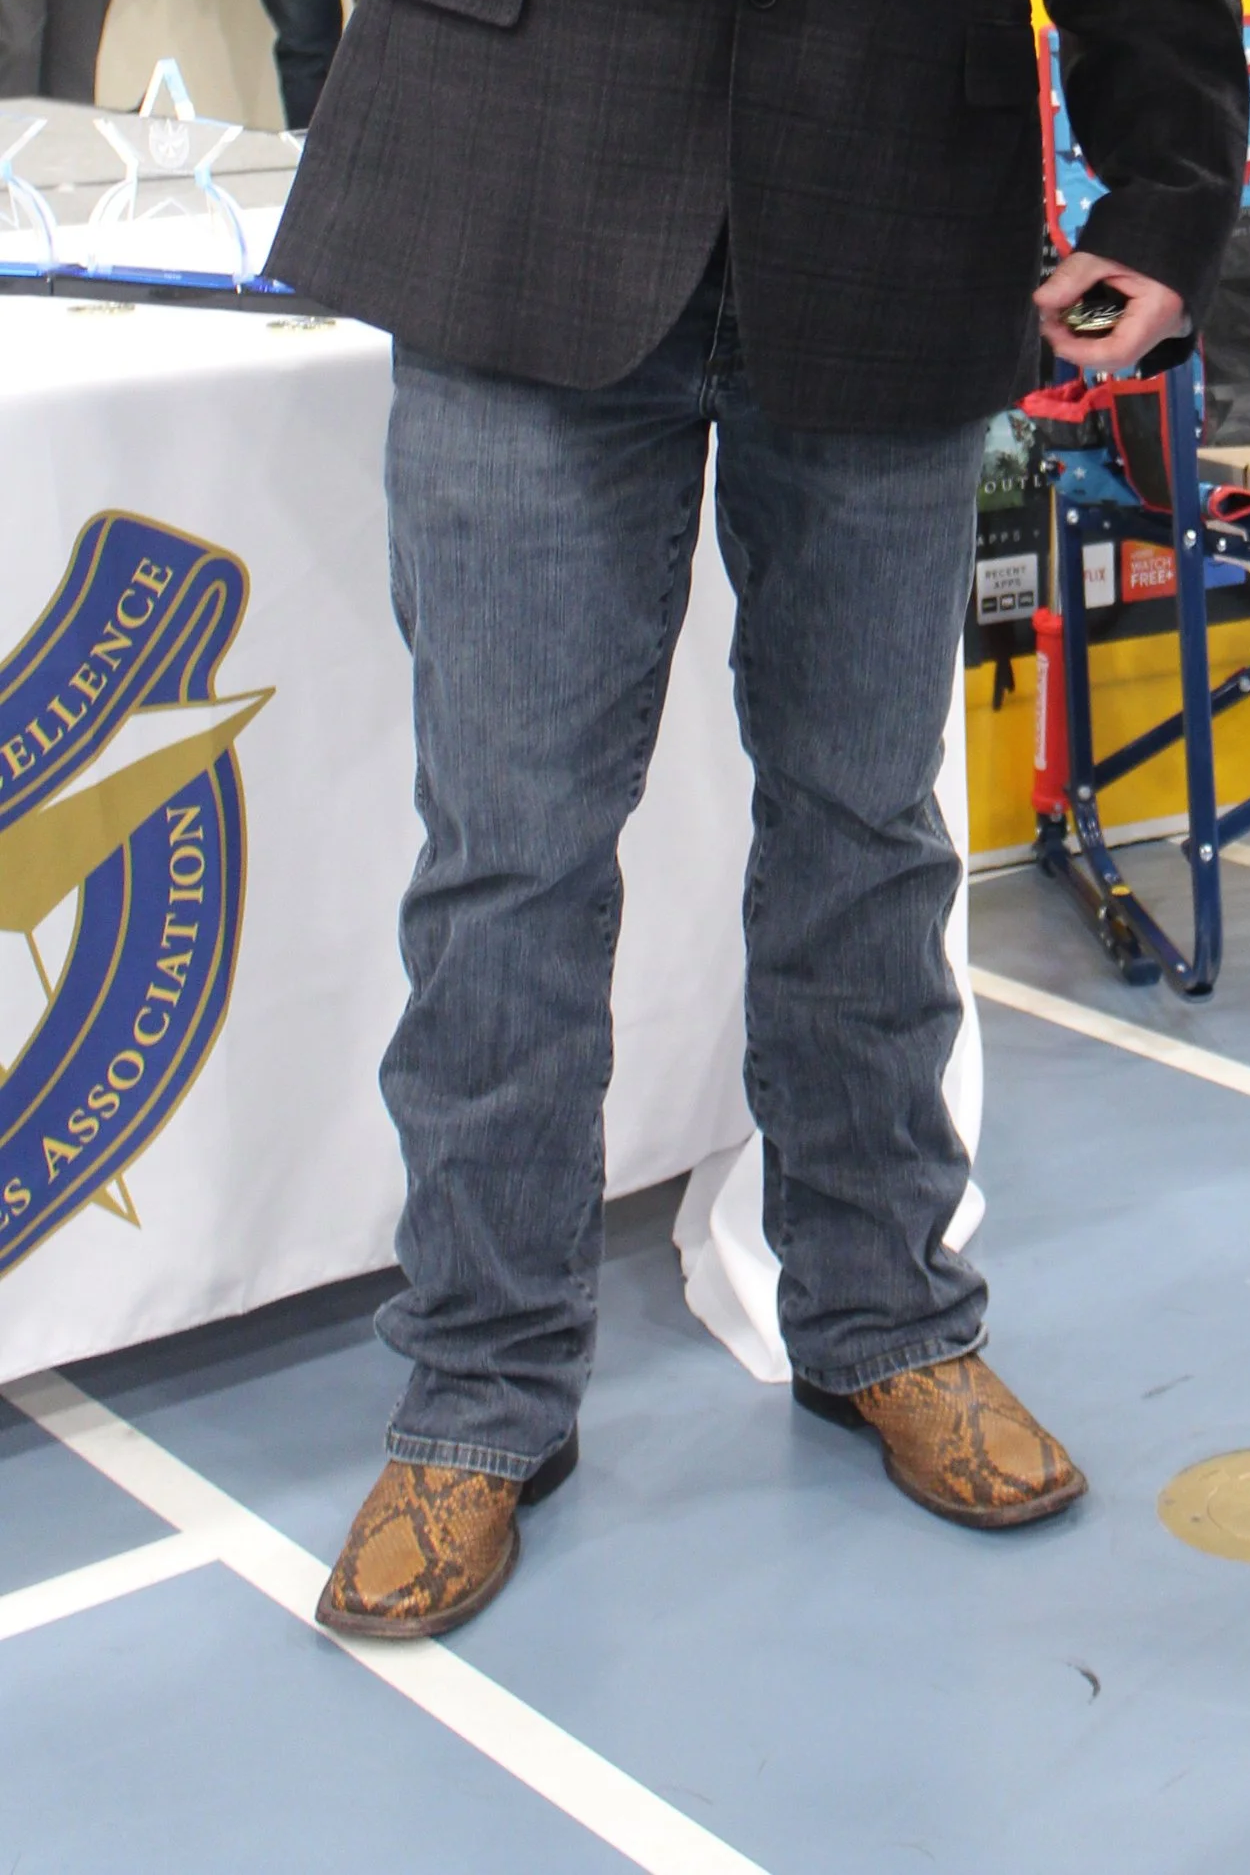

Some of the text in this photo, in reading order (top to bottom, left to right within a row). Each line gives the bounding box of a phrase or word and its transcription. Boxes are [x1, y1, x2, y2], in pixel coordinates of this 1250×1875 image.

[984, 473, 1042, 495] OUTL
[1083, 567, 1106, 583] FLIX
[0, 557, 173, 791] ELLENCE
[42, 804, 206, 1185] ASSOCIATION
